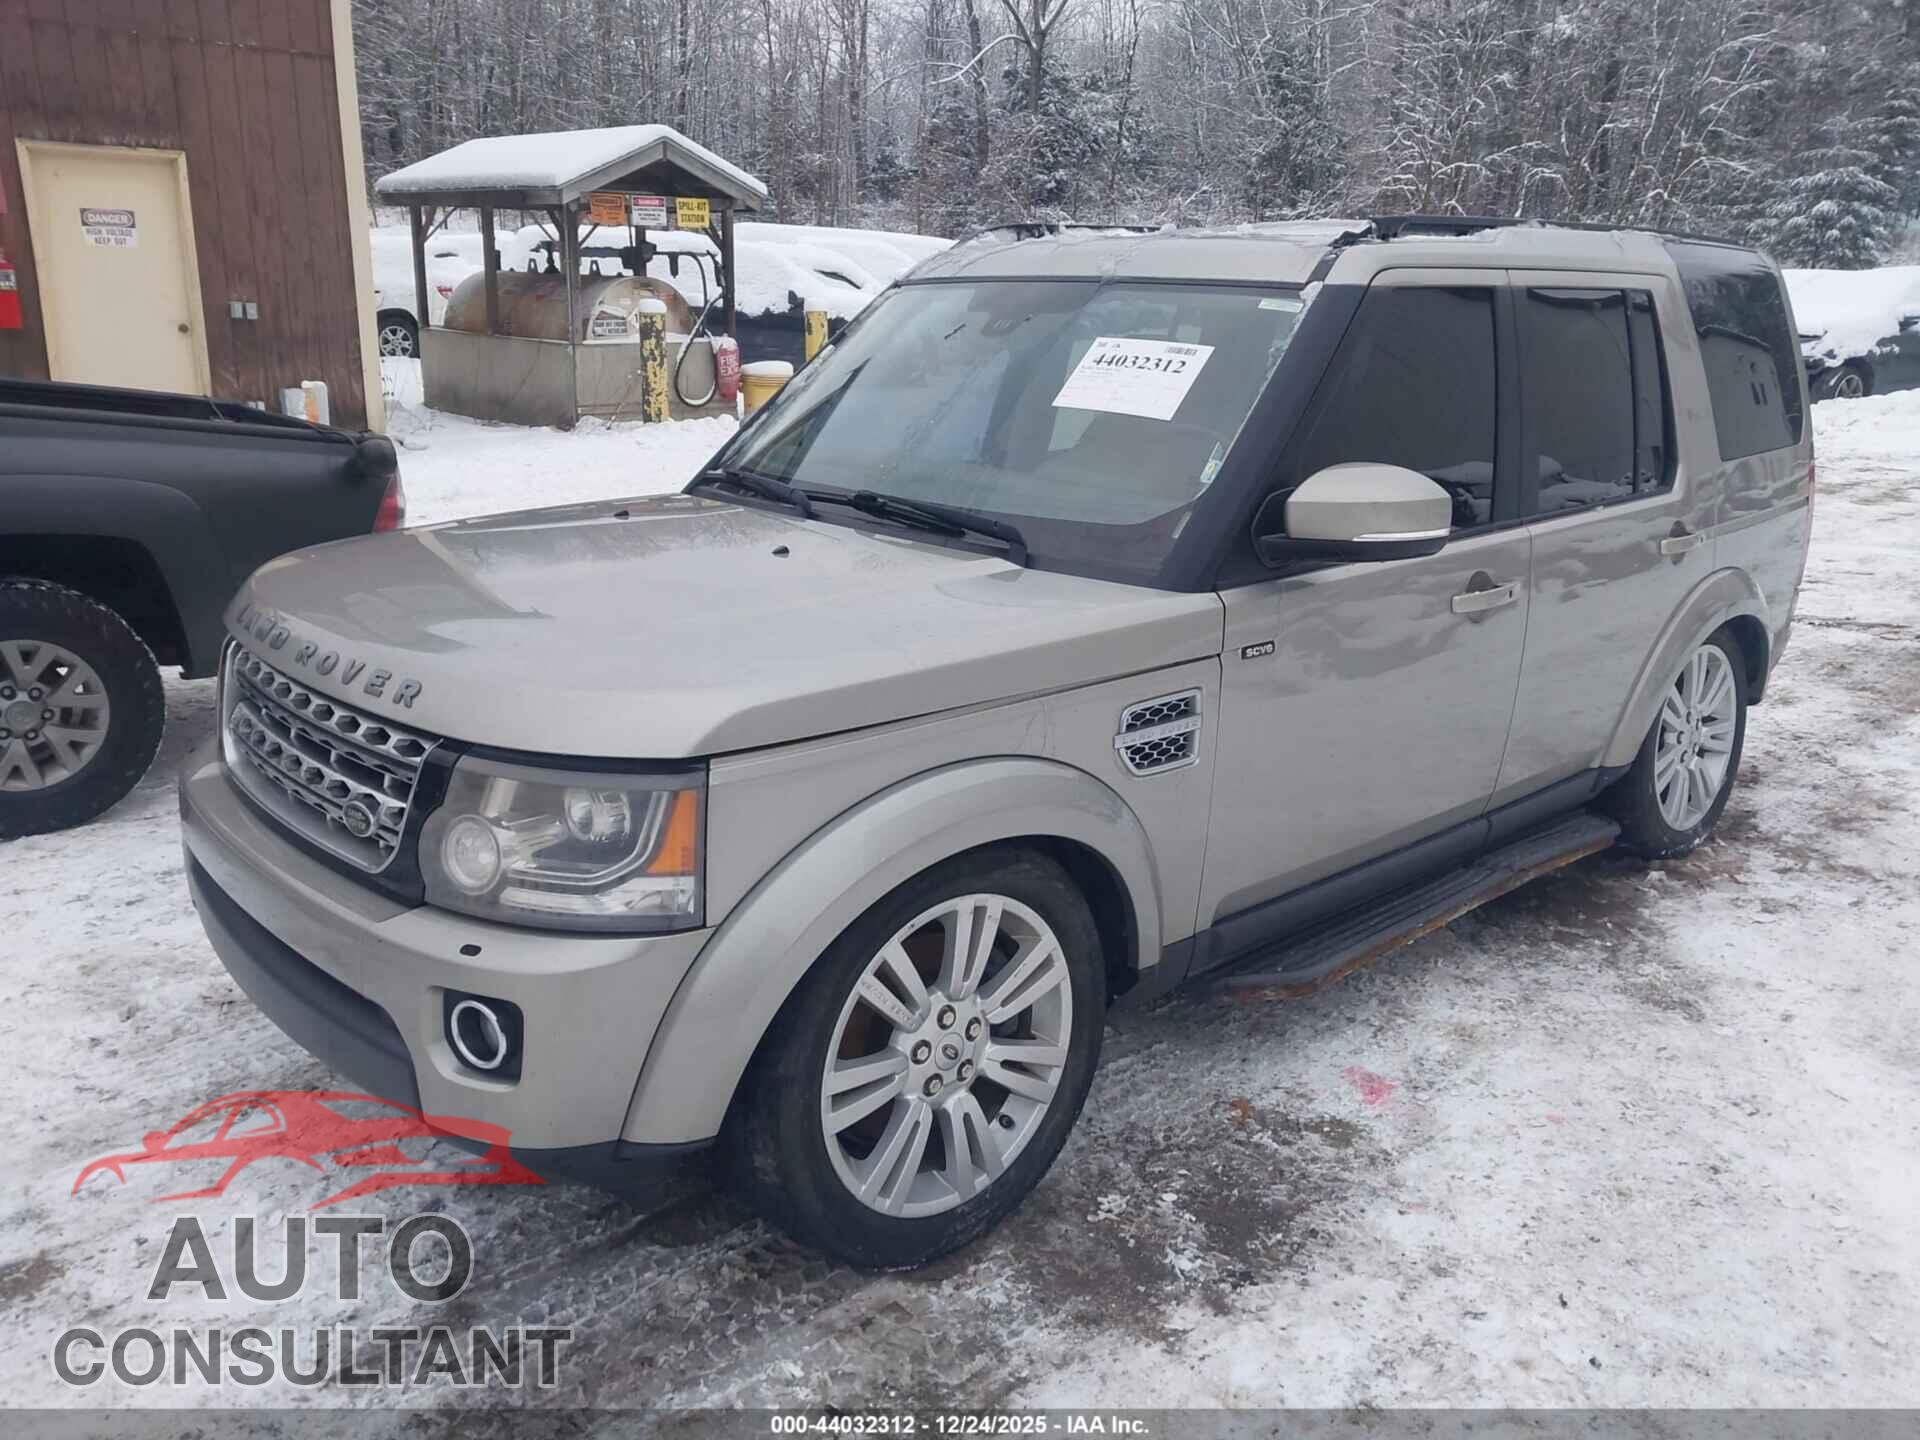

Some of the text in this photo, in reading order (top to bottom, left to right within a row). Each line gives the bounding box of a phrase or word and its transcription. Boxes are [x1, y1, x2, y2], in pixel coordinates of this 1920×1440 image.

[87, 213, 129, 225] DANGER
[680, 213, 705, 223] STATION
[1093, 352, 1187, 374] 44032312
[236, 602, 423, 710] LAND ROVER
